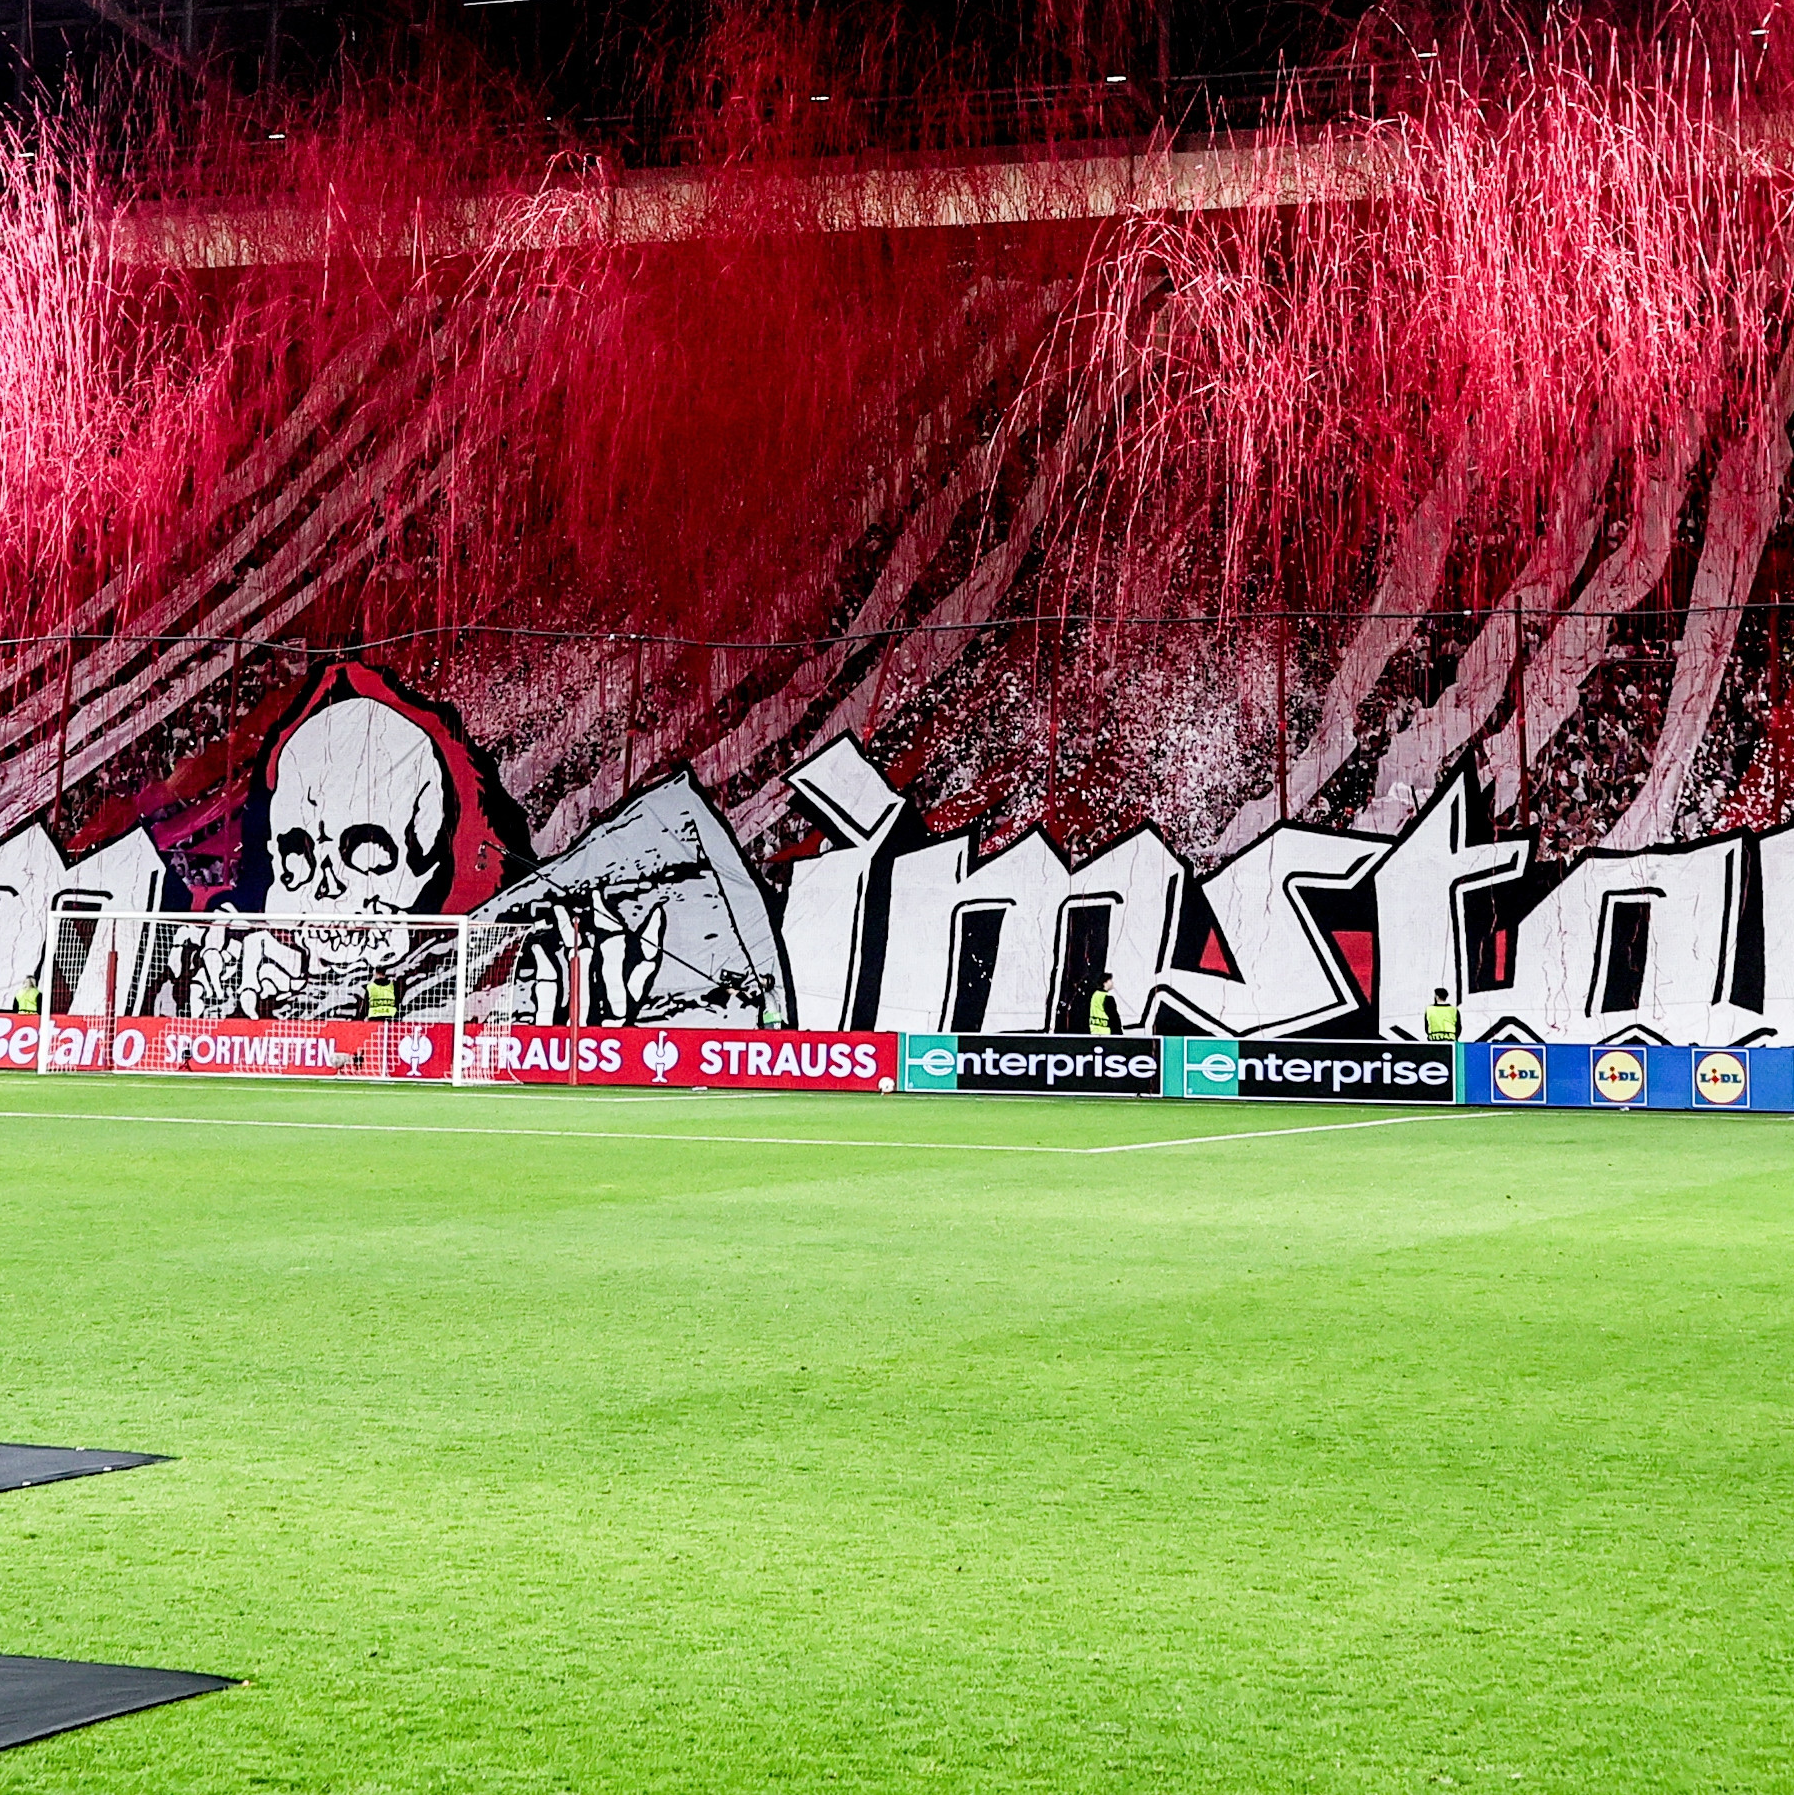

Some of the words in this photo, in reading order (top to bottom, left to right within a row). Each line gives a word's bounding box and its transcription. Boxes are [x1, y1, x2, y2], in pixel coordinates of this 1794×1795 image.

[165, 1034, 337, 1068] SPORTWETTEN
[461, 1035, 622, 1073] STRAUSS
[700, 1041, 877, 1079] STRAUSS
[920, 1046, 1158, 1085] enterprise
[1202, 1052, 1450, 1092] enterprise
